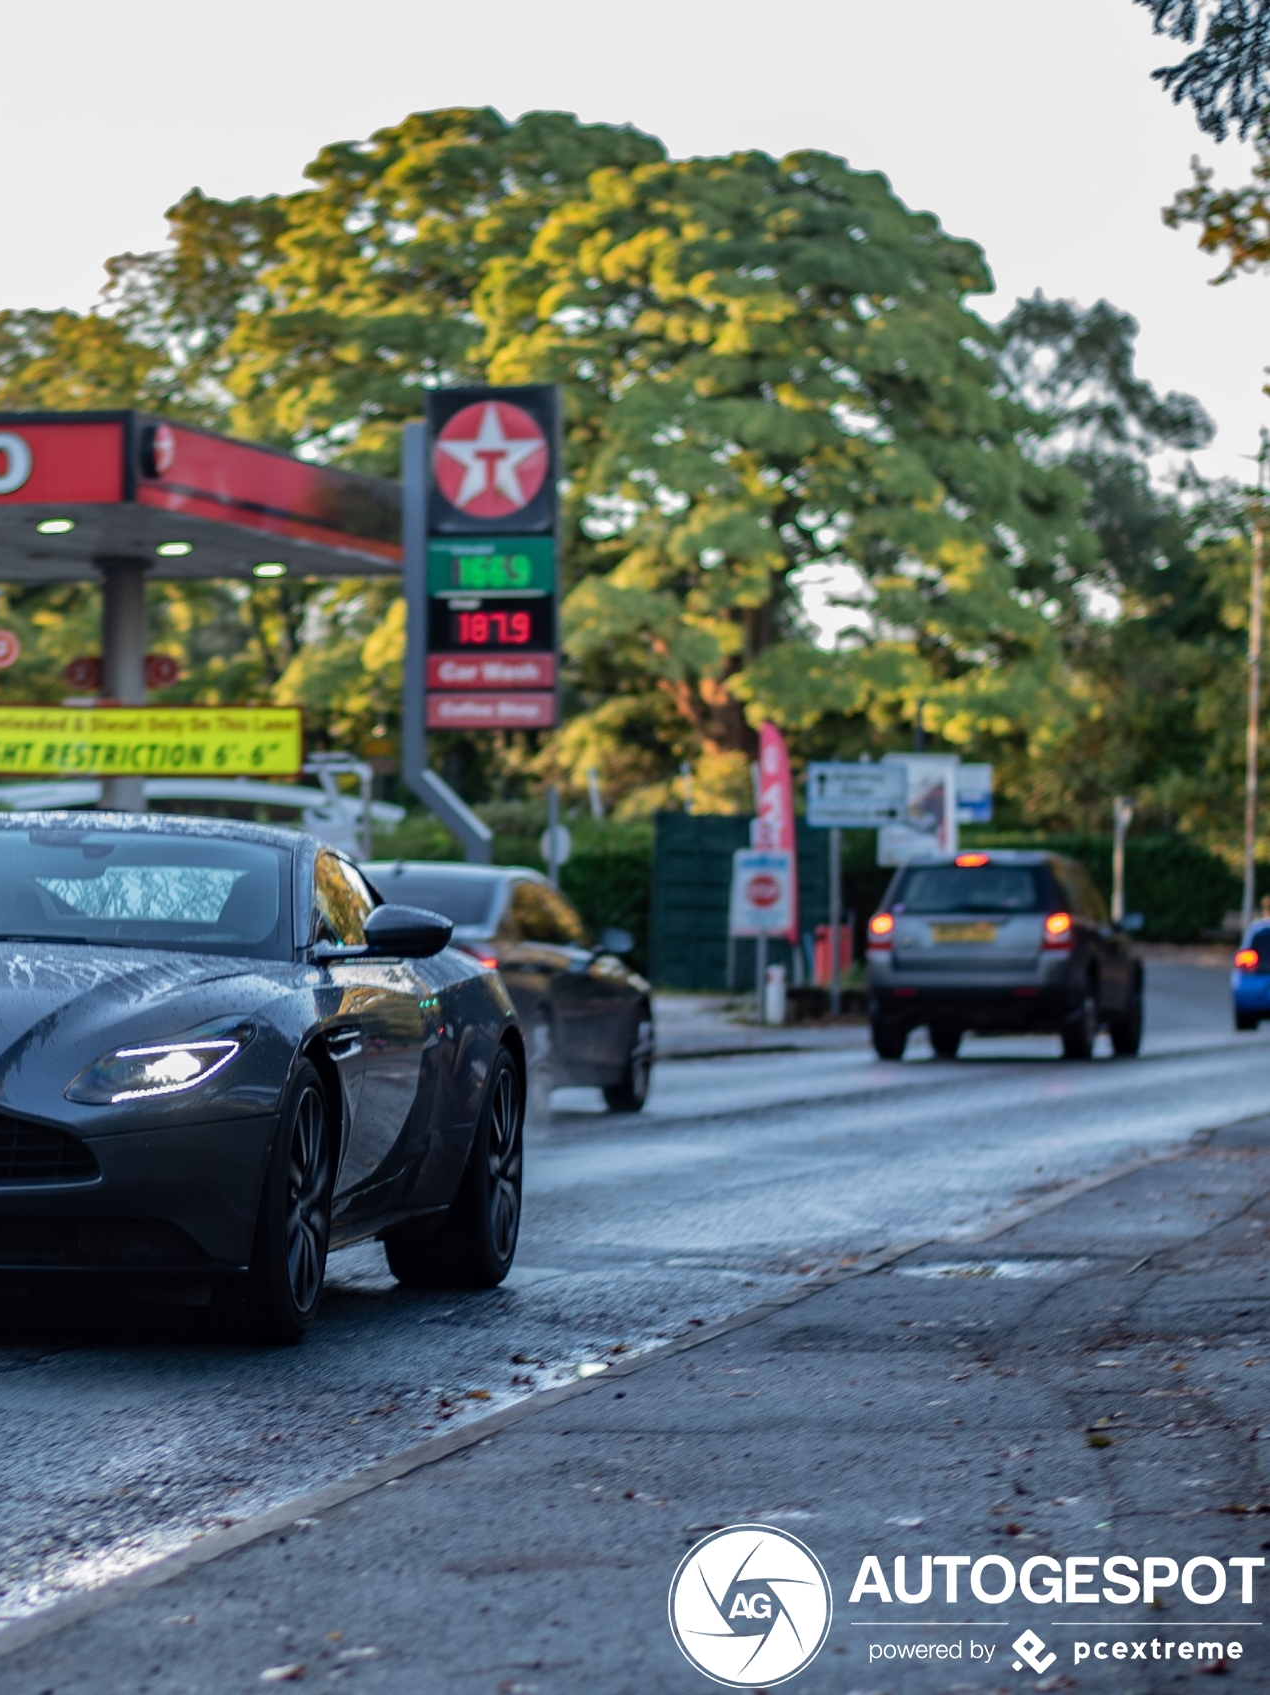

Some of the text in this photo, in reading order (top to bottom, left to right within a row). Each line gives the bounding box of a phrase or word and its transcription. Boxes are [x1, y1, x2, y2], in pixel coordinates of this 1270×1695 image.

[438, 662, 540, 682] Car Wash
[41, 741, 205, 768] RESTRICTION
